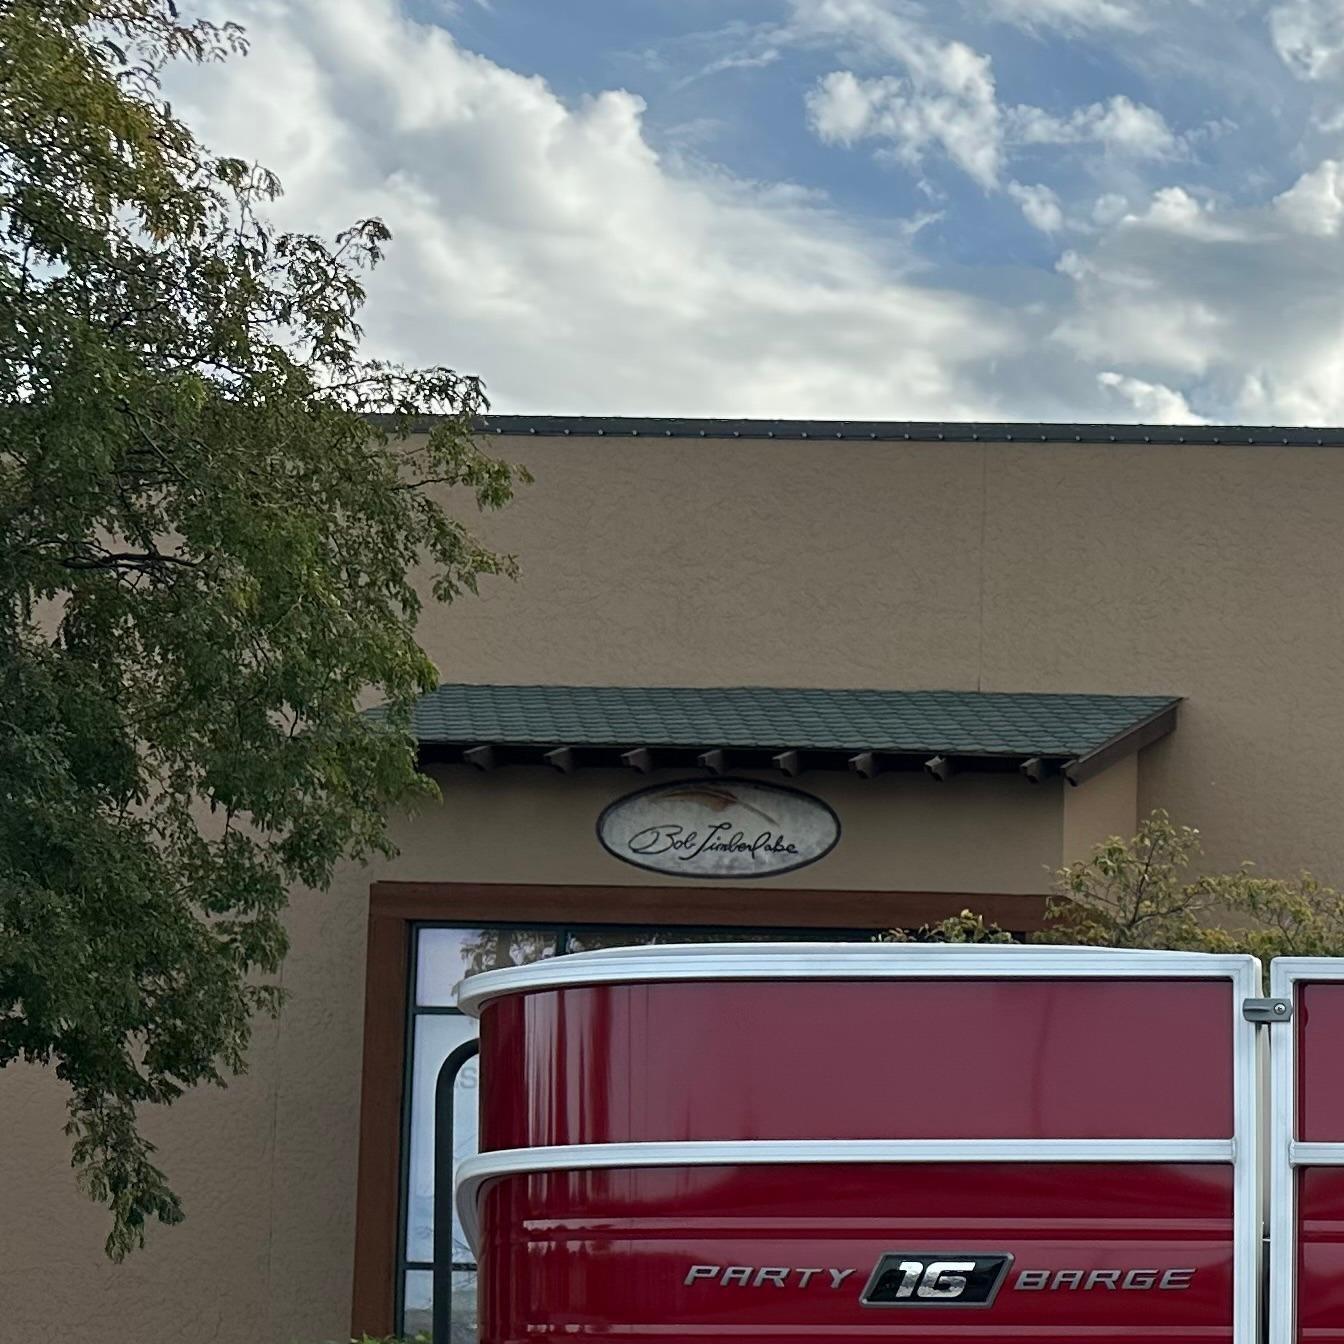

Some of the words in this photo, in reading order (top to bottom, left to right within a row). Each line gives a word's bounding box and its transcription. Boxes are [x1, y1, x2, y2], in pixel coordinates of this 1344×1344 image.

[628, 824, 697, 854] Bob
[682, 1265, 857, 1289] PARTY
[898, 1260, 977, 1299] 16
[1013, 1267, 1199, 1291] BARGE
